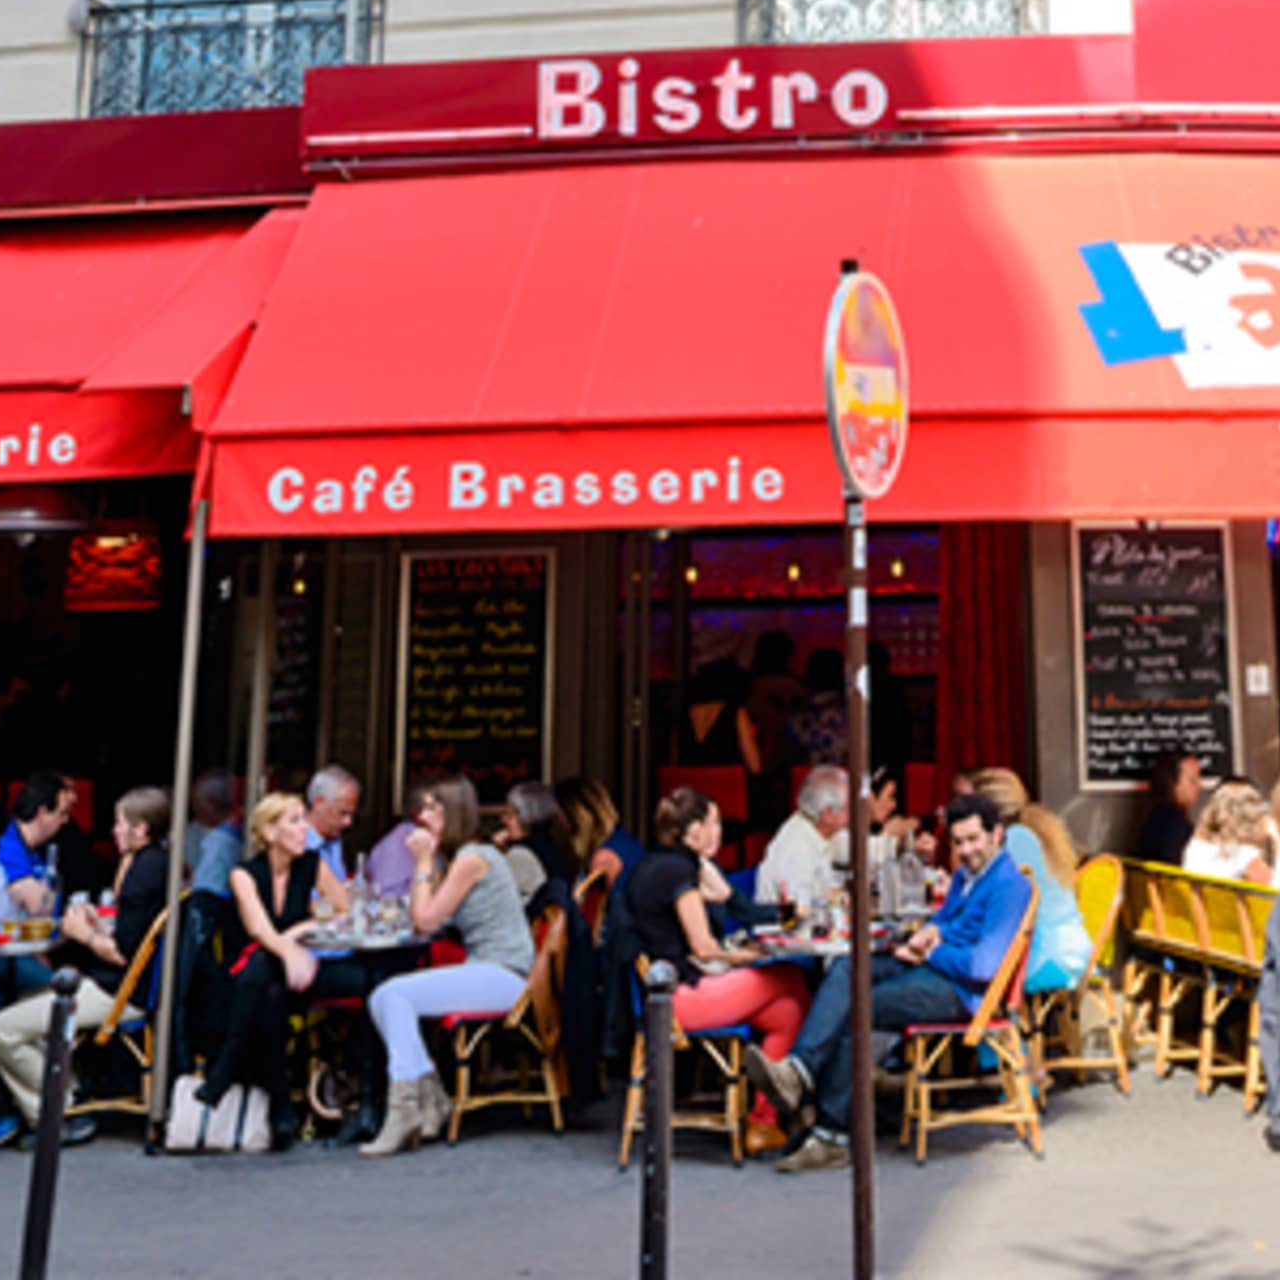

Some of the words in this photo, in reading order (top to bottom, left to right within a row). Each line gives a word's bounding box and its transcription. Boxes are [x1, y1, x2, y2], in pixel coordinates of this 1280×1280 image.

[536, 58, 889, 140] Bistro
[266, 464, 414, 513] Café
[448, 456, 786, 510] Brasserie
